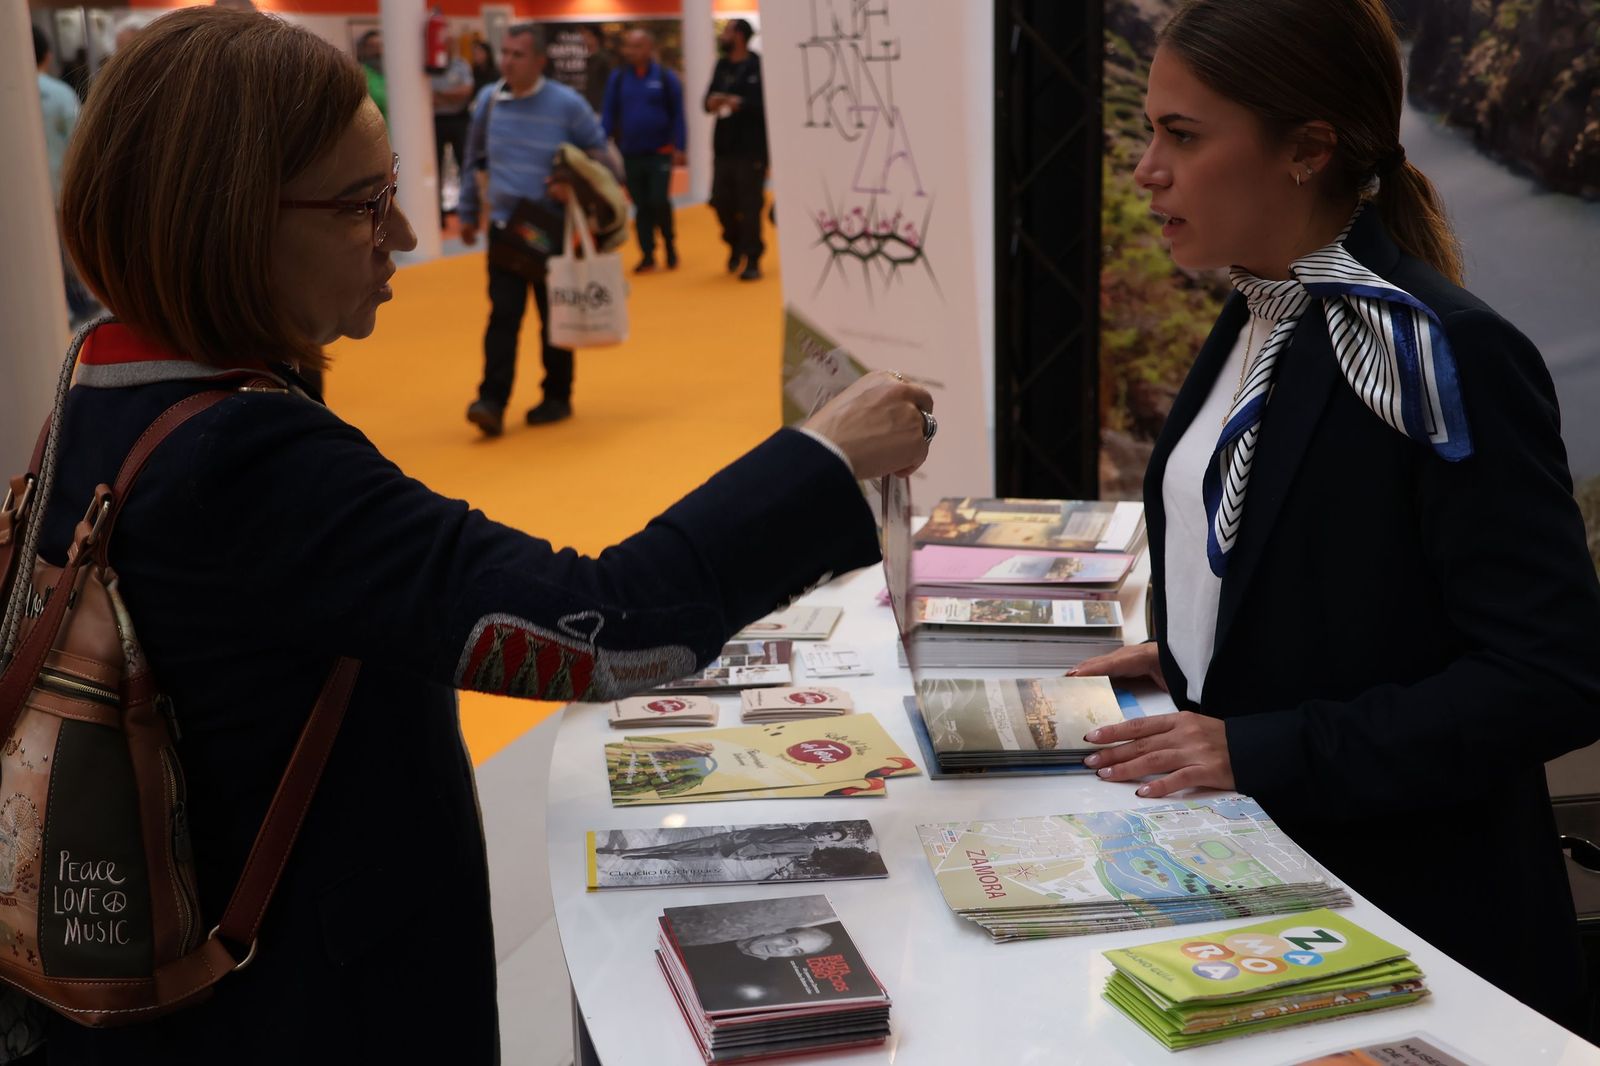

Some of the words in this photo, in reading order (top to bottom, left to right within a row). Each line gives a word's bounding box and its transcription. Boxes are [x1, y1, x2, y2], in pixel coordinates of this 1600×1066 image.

[59, 850, 126, 884] Peace
[966, 849, 1007, 899] ZAMORA
[54, 885, 101, 914] LOVE
[64, 917, 130, 945] MUSIC
